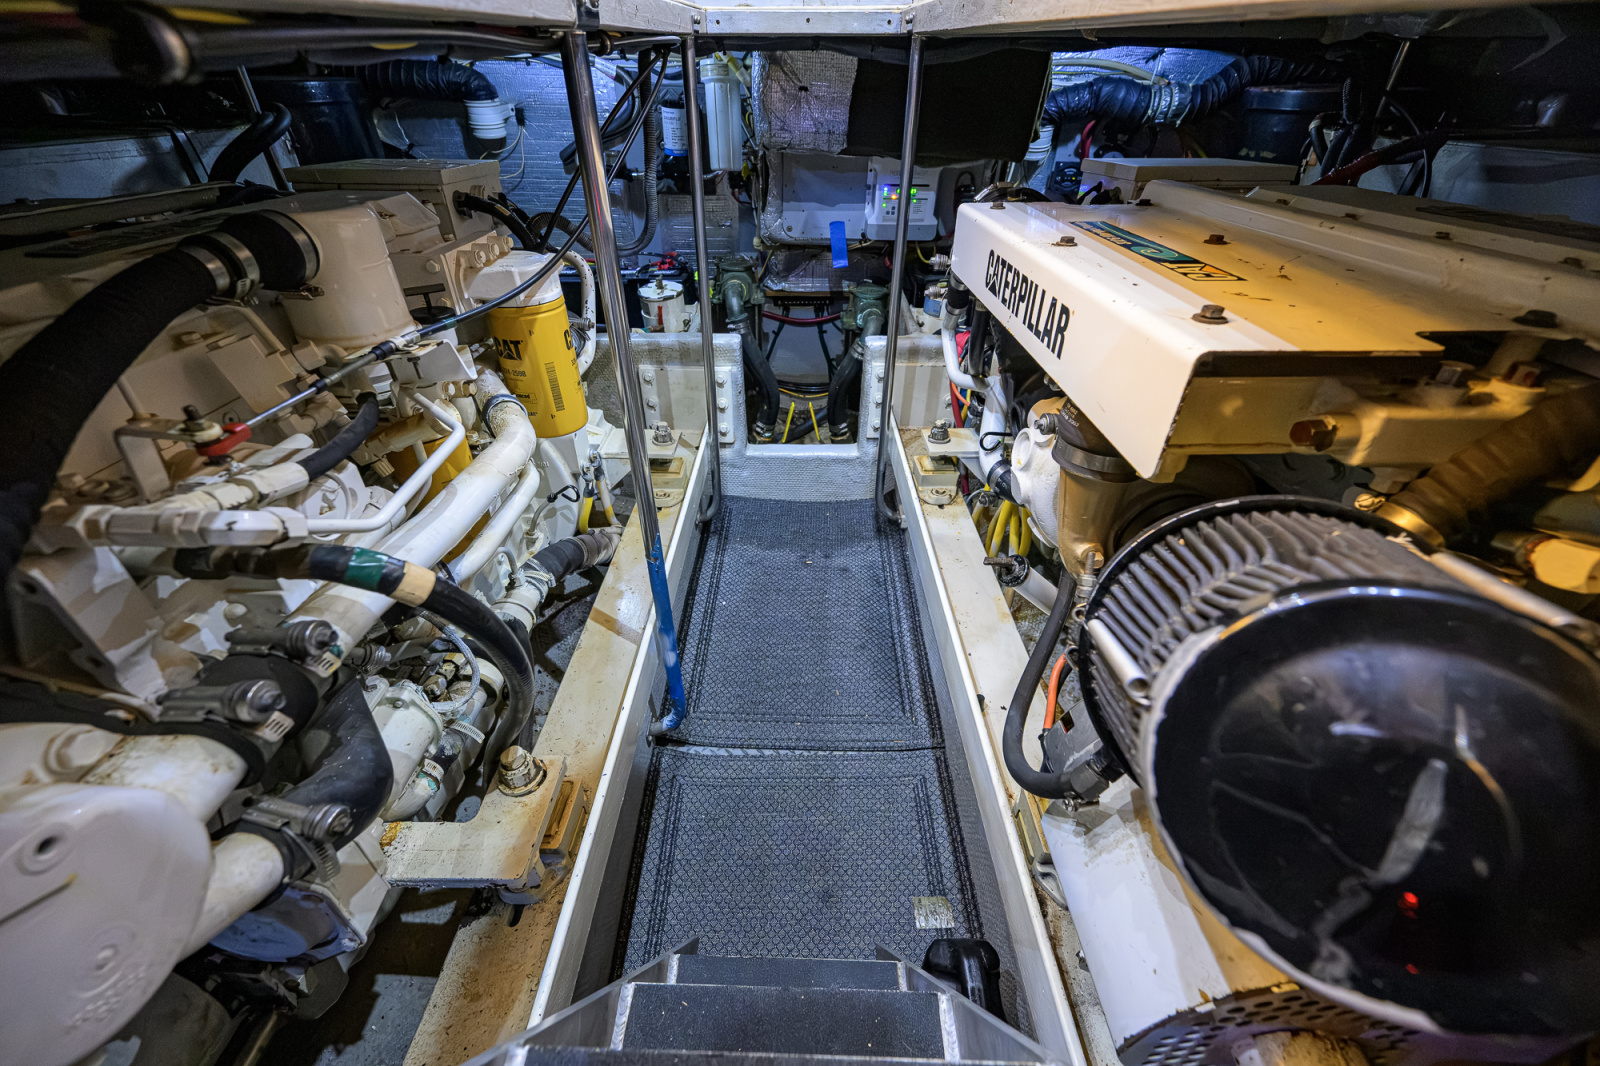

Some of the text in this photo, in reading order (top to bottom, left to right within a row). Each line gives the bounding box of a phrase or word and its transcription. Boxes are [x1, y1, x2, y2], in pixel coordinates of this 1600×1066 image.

[1160, 262, 1239, 281] CAT
[985, 249, 1071, 361] CATERPILLAR
[493, 336, 523, 361] CAT
